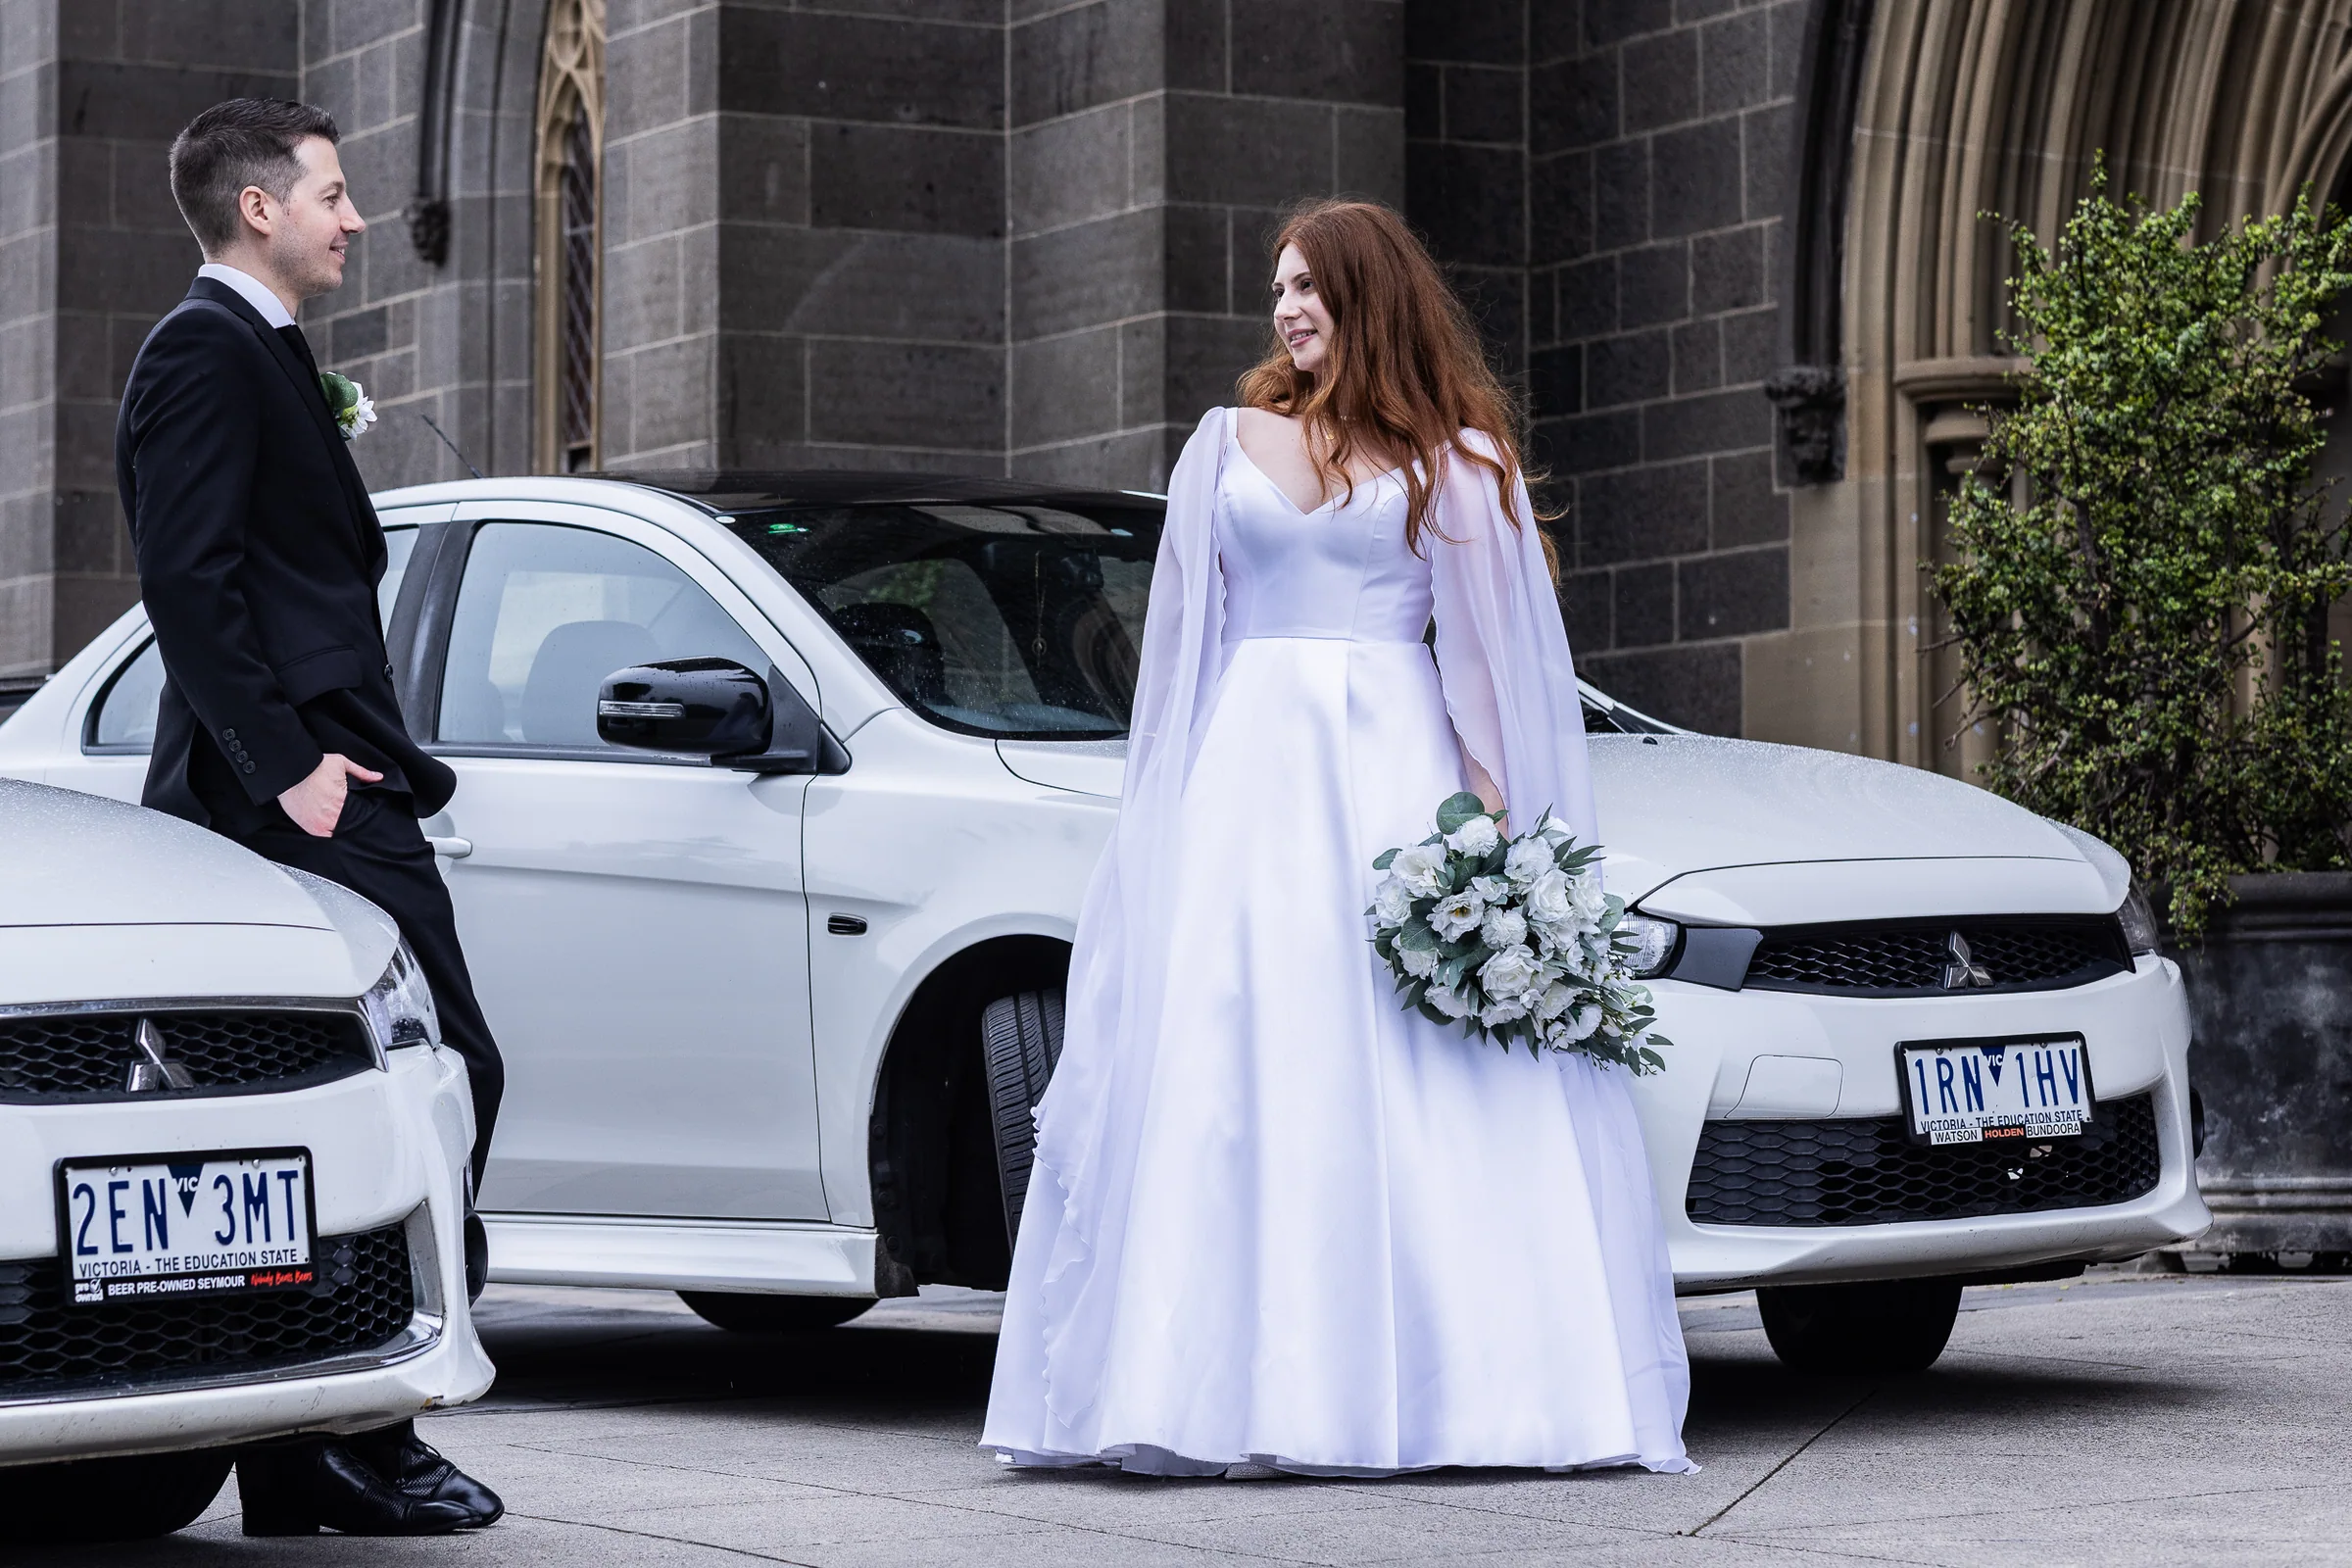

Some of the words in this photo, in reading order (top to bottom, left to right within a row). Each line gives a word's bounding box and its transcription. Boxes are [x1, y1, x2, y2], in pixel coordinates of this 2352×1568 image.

[1985, 1054, 2003, 1067] VIC
[1915, 1054, 1984, 1115] 1RN
[2015, 1048, 2079, 1108] 1HV
[1920, 1118, 1967, 1133] VICTORIA
[1976, 1116, 1995, 1128] THE
[1997, 1111, 2052, 1126] EDUCATION
[2054, 1109, 2083, 1123] STATE
[1935, 1129, 1979, 1144] WATSON
[1984, 1127, 2025, 1139] HOLDEN
[2027, 1122, 2081, 1137] BUNDOORA
[173, 1176, 198, 1194] VIC
[73, 1177, 169, 1256] 2EN
[213, 1169, 299, 1247] 3MT
[78, 1259, 142, 1278] VICTORIA
[155, 1256, 180, 1272] THE
[184, 1250, 257, 1271] EDUCATION
[261, 1249, 298, 1265] STATE
[107, 1282, 136, 1296] BEER
[136, 1278, 196, 1295] PRE-OWNED
[197, 1275, 246, 1291] SEYMOUR
